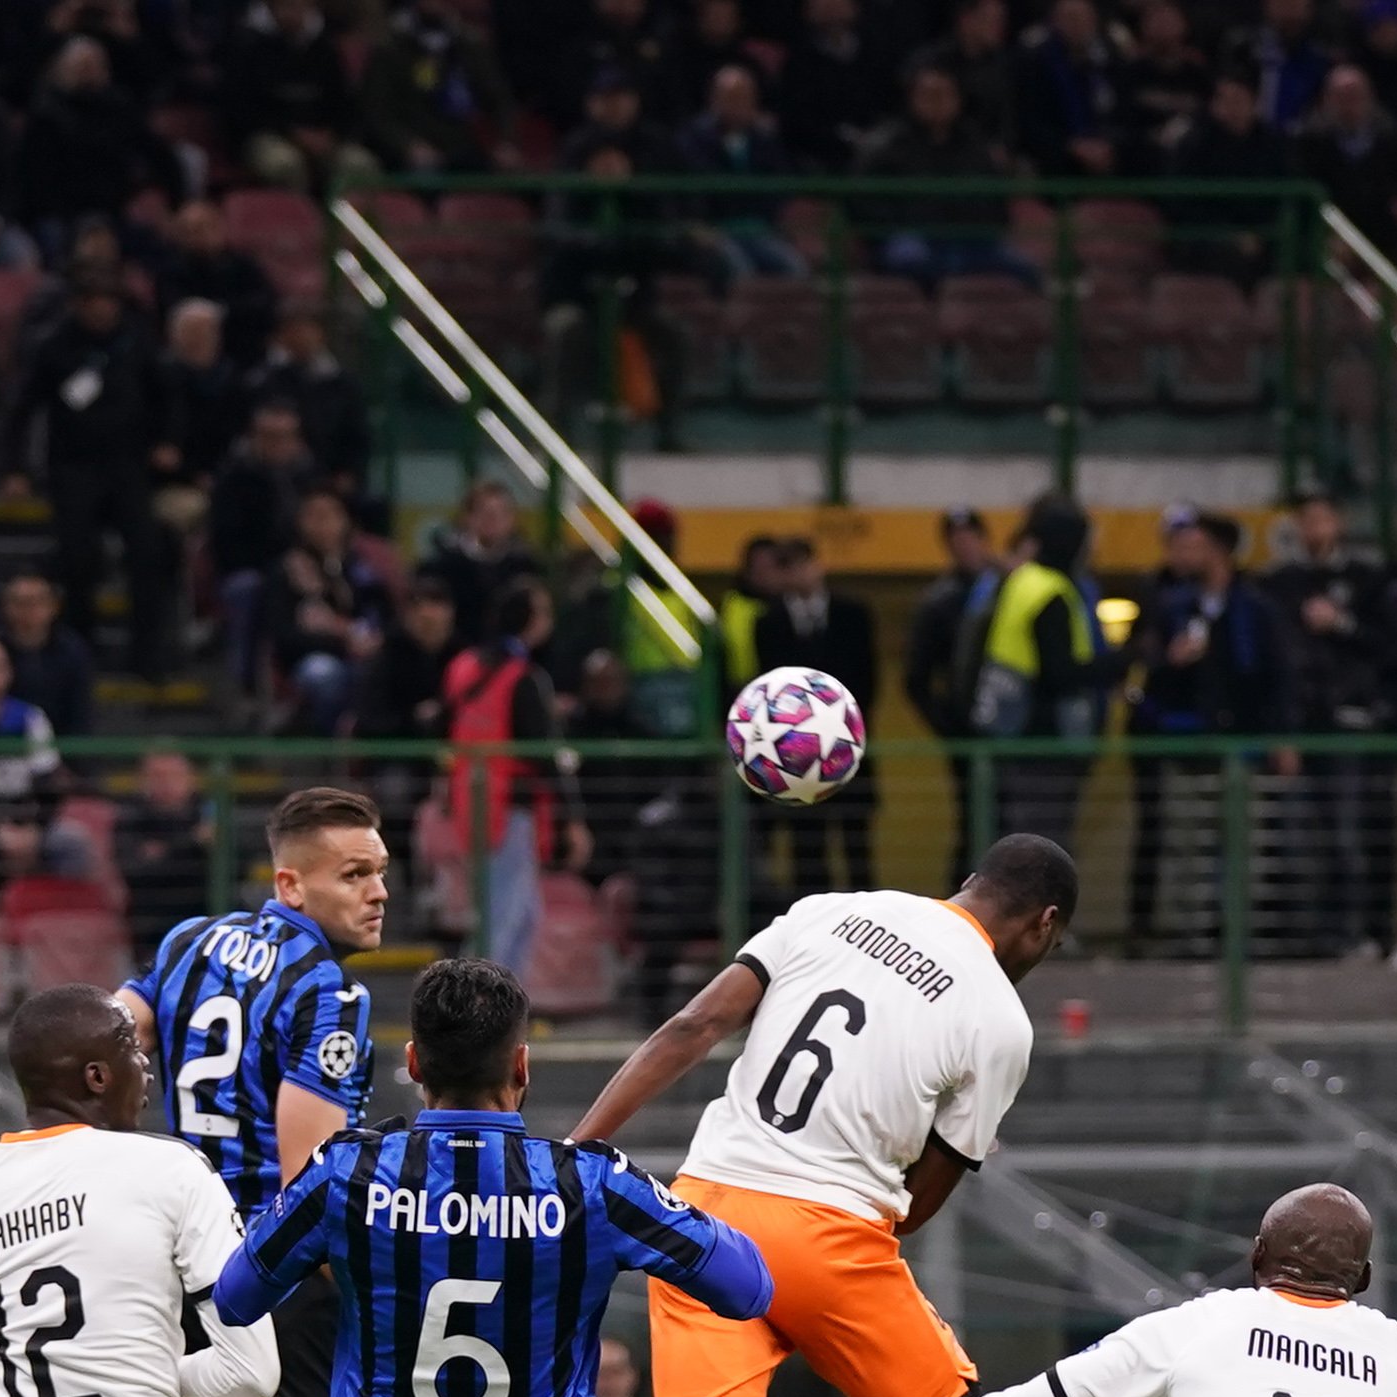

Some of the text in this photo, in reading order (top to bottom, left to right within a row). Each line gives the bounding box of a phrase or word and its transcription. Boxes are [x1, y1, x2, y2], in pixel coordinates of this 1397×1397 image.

[204, 925, 279, 983] TOLOI
[832, 913, 953, 1003] KONDOGBIA
[176, 996, 244, 1138] 2
[757, 989, 866, 1133] 6
[365, 1182, 566, 1239] PALOMINO
[1247, 1327, 1377, 1386] MANGALA
